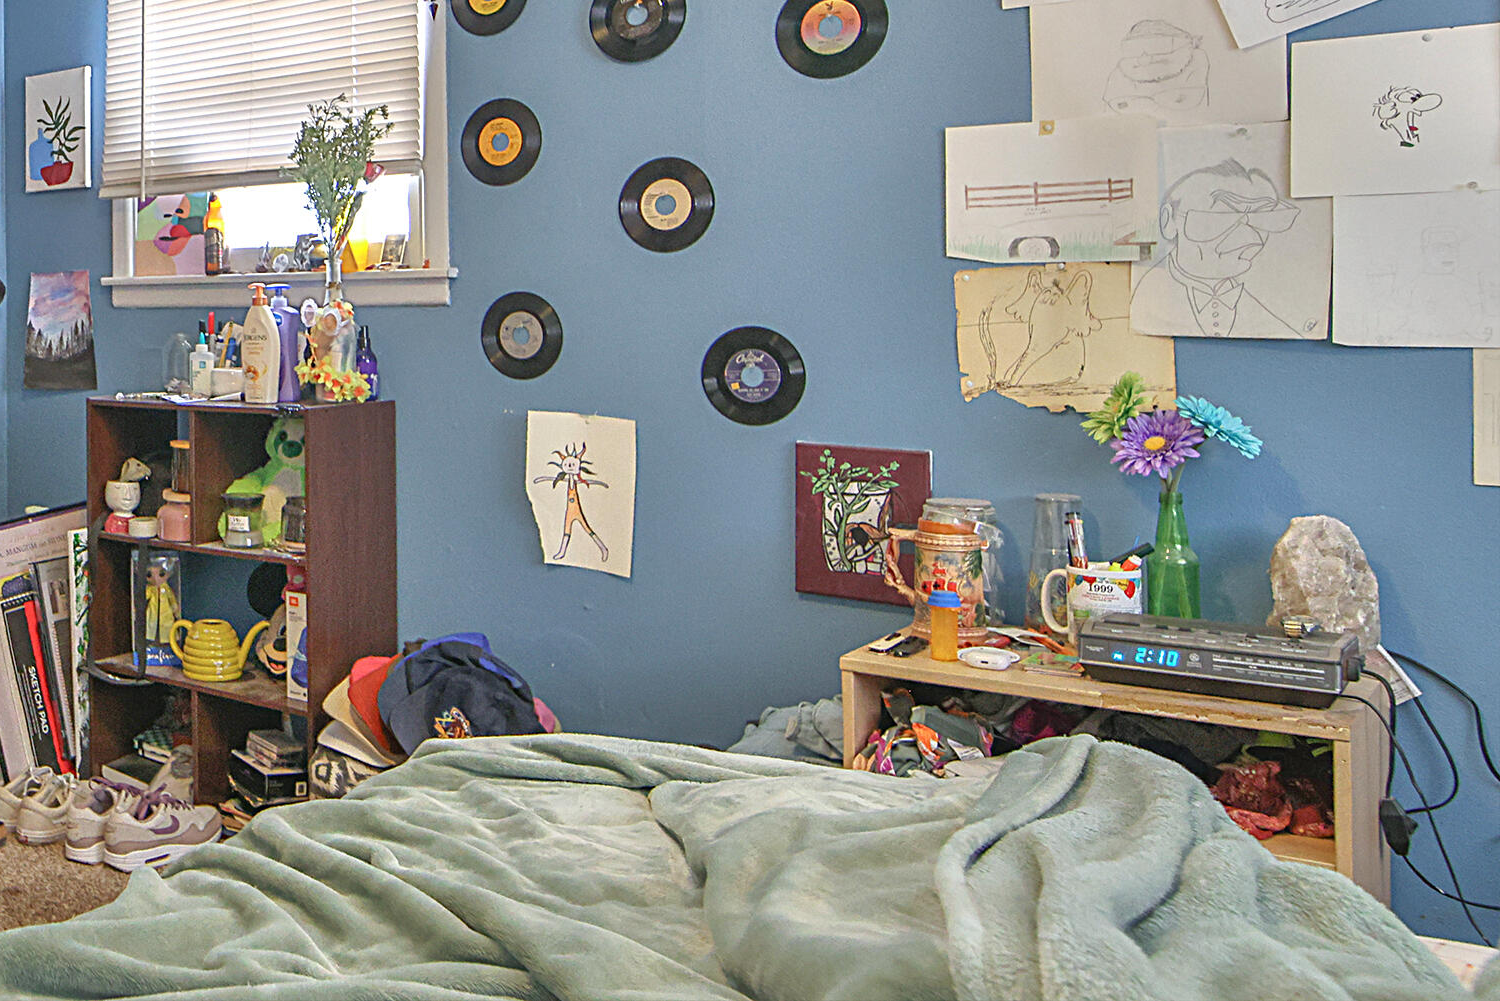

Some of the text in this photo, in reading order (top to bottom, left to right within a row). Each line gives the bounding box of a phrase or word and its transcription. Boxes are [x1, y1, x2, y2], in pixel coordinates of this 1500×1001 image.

[1088, 584, 1113, 593] 1999
[1134, 647, 1180, 668] 2:10
[28, 665, 45, 709] SKETCH
[37, 710, 50, 734] PAD
